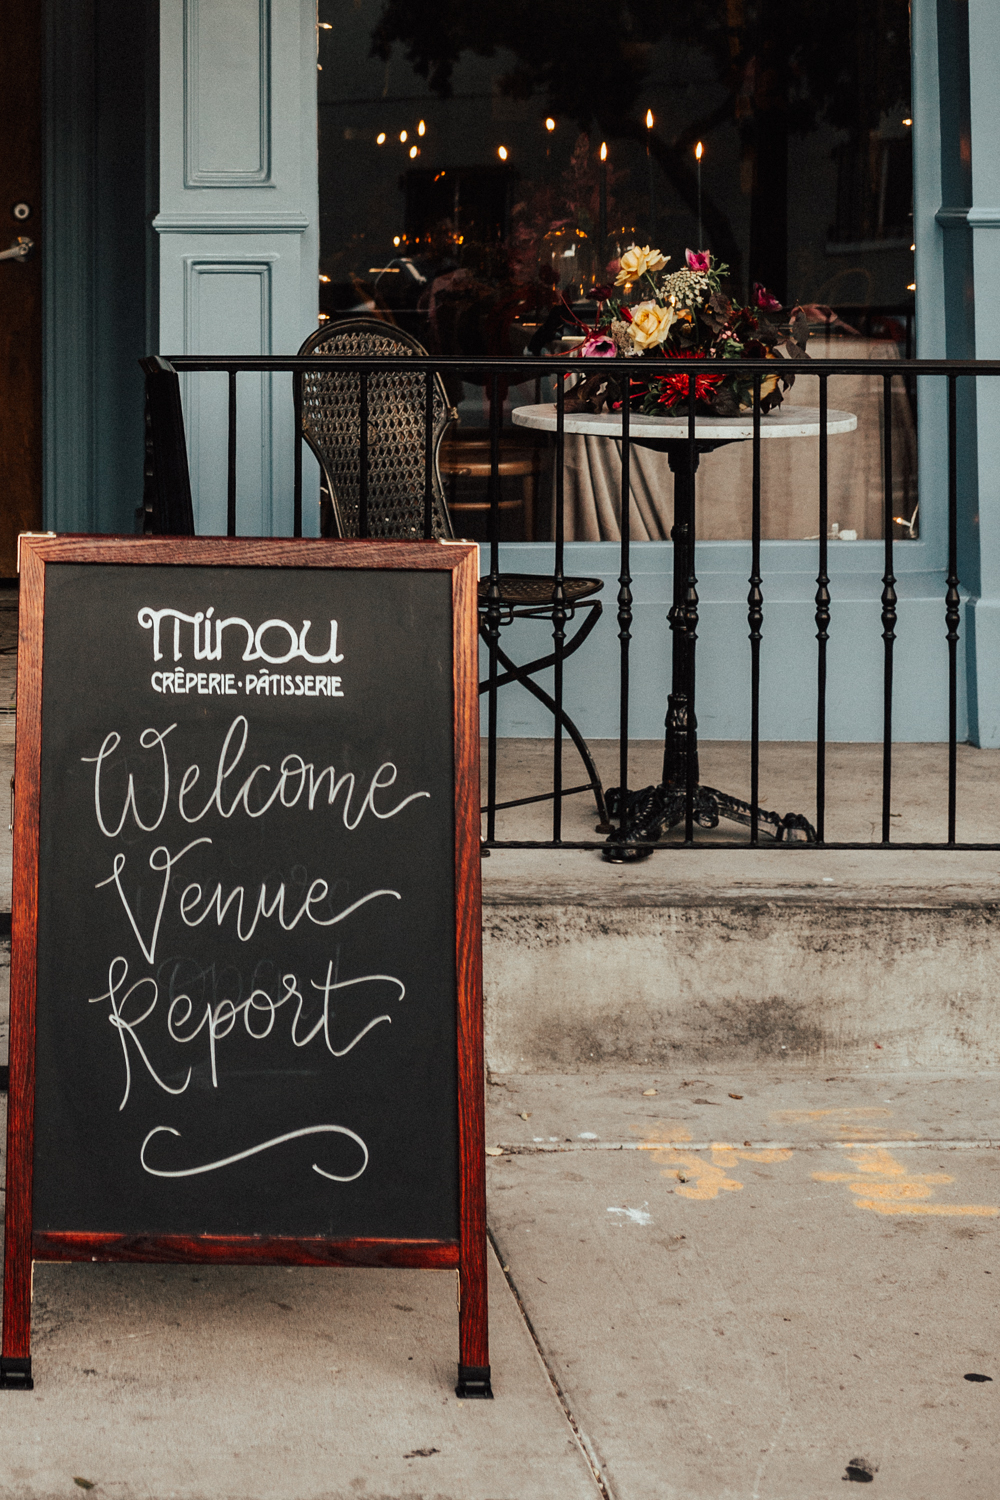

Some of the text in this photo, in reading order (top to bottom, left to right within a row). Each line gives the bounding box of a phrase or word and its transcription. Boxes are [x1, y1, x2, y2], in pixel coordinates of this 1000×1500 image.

[137, 606, 345, 664] Minou
[80, 714, 431, 837] Welcome
[95, 837, 401, 965] Venue
[88, 956, 406, 1111] Report
